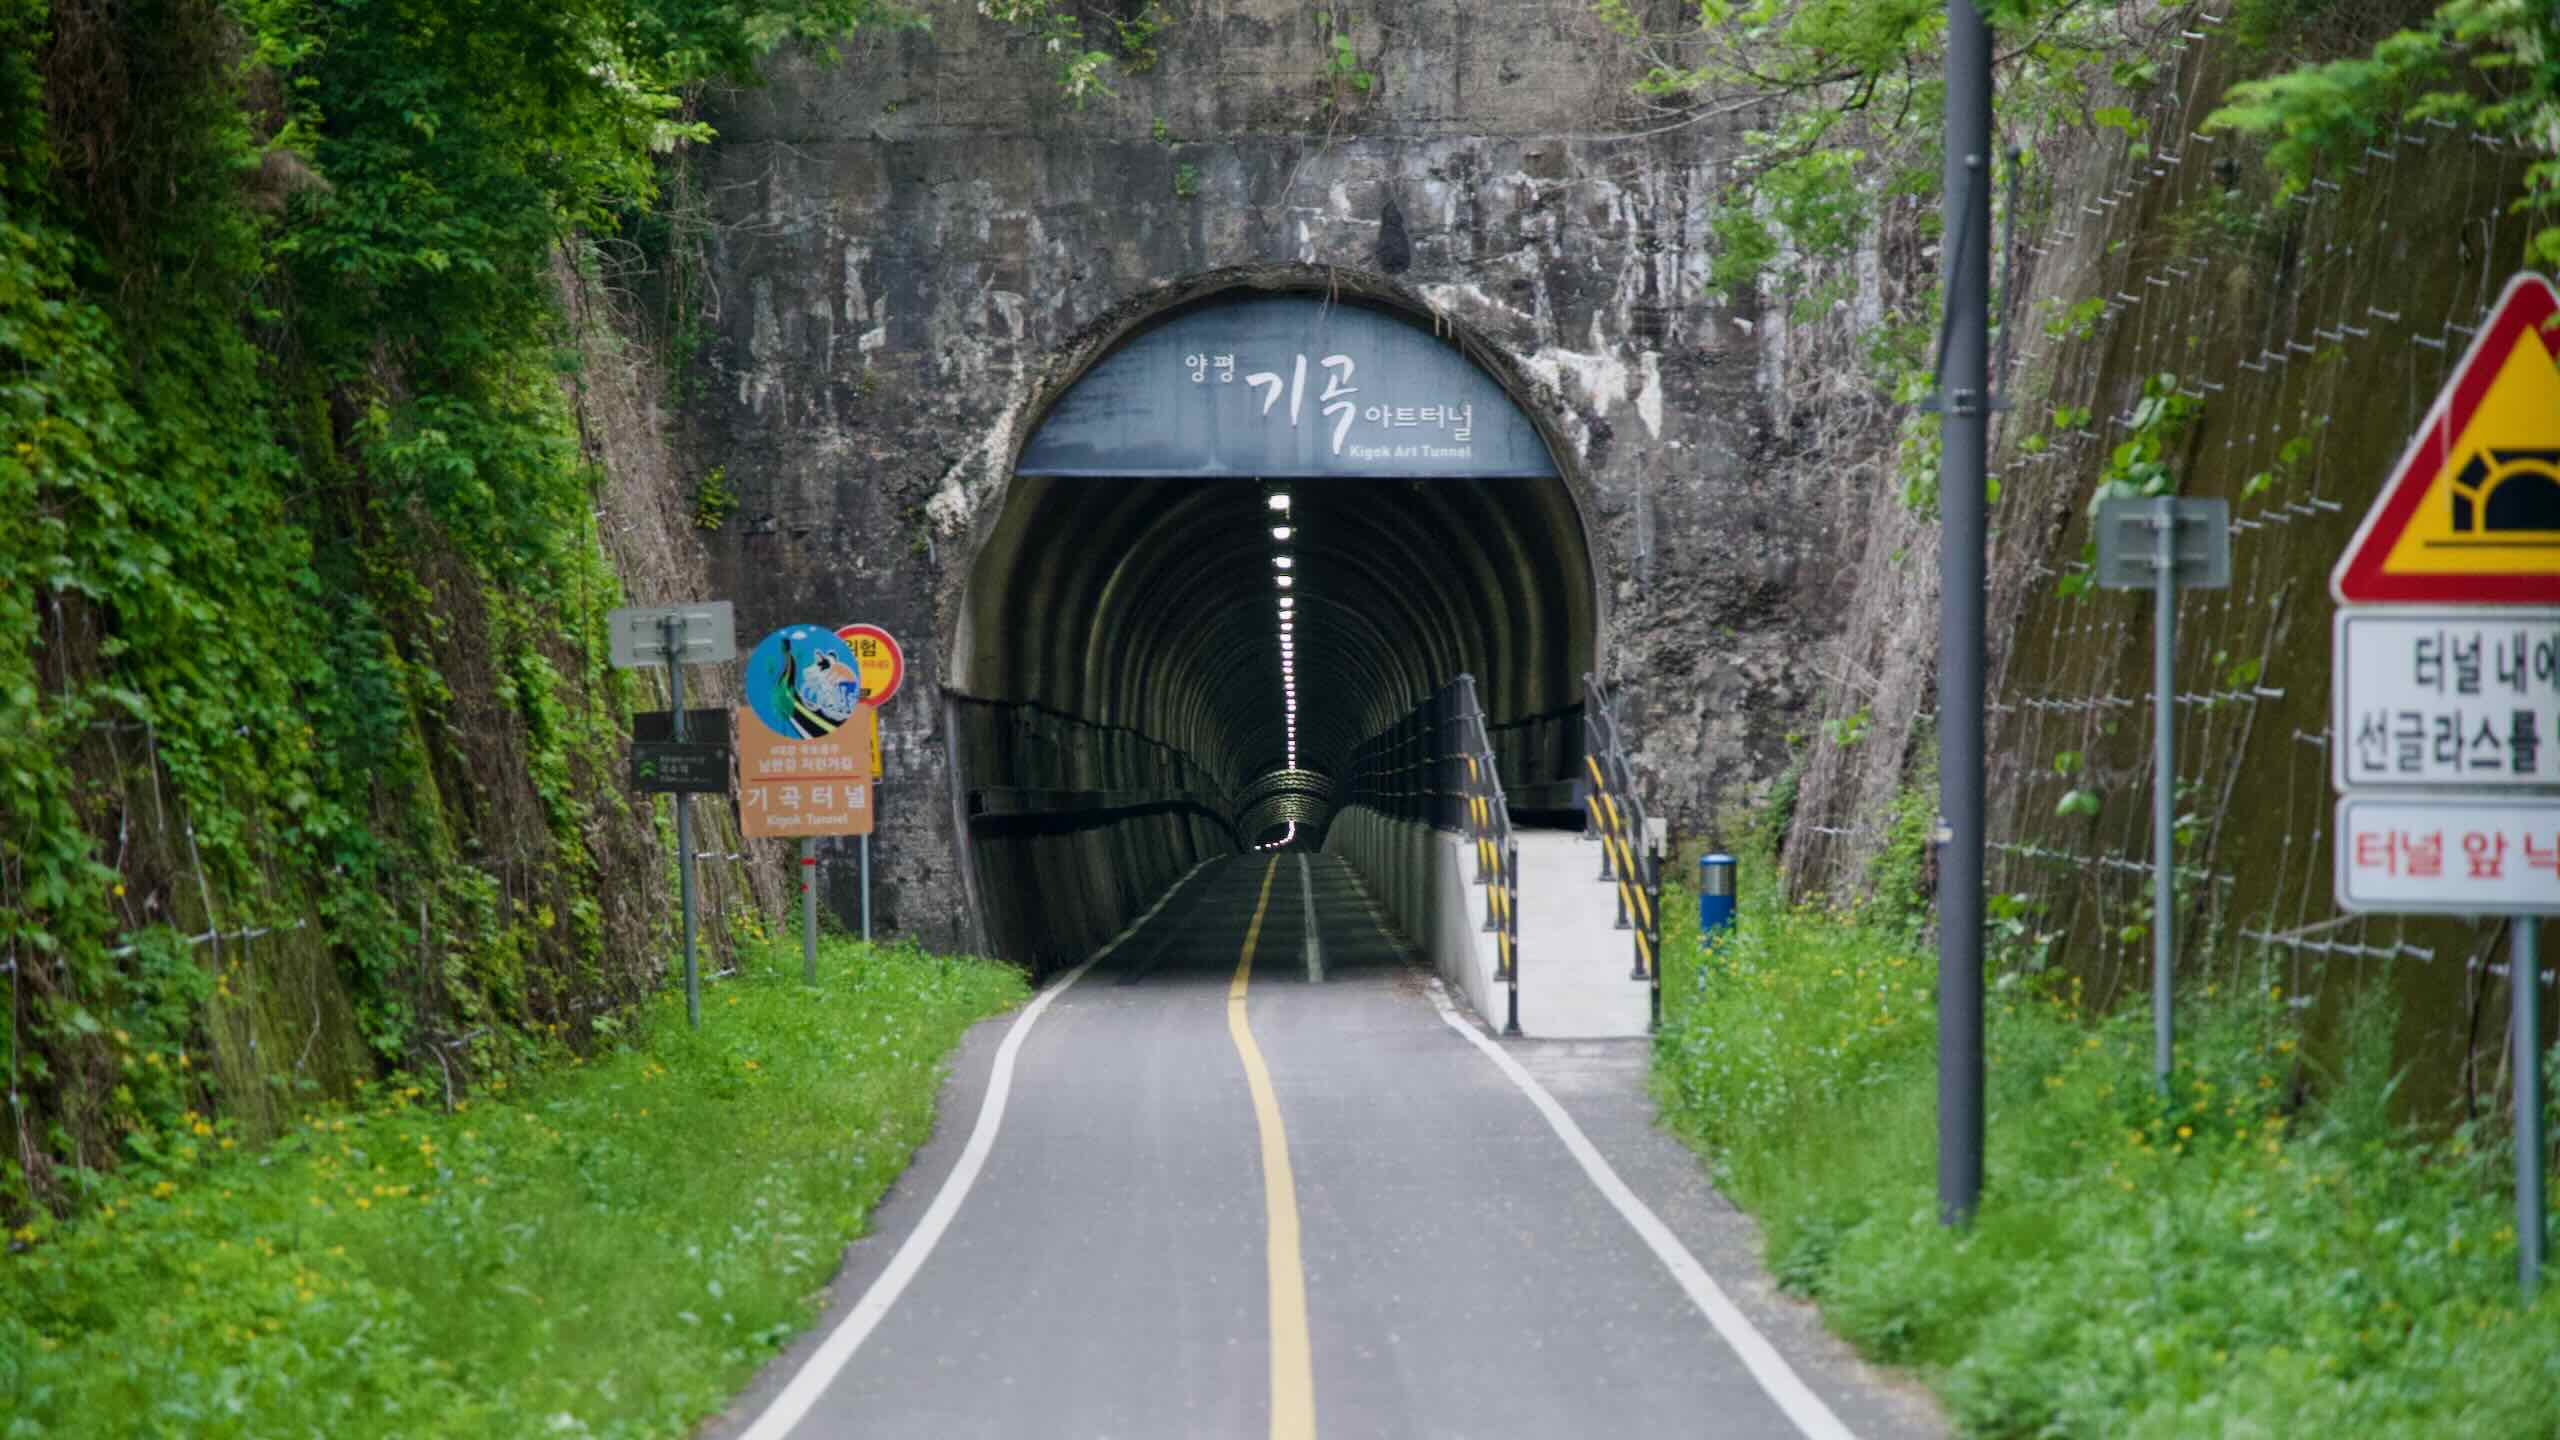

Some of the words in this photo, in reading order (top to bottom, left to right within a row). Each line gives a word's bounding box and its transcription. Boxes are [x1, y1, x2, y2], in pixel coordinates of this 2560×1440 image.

[1185, 353, 1234, 383] 양평
[1246, 353, 1359, 455] 기곡
[1365, 404, 1472, 441] 아트터널
[1393, 446, 1418, 457] Art
[1421, 446, 1472, 458] Tunnel
[2415, 630, 2481, 694] 터널
[2357, 708, 2540, 774] 선글라스를
[2356, 830, 2443, 878] 터널
[2463, 832, 2508, 879] 앞
